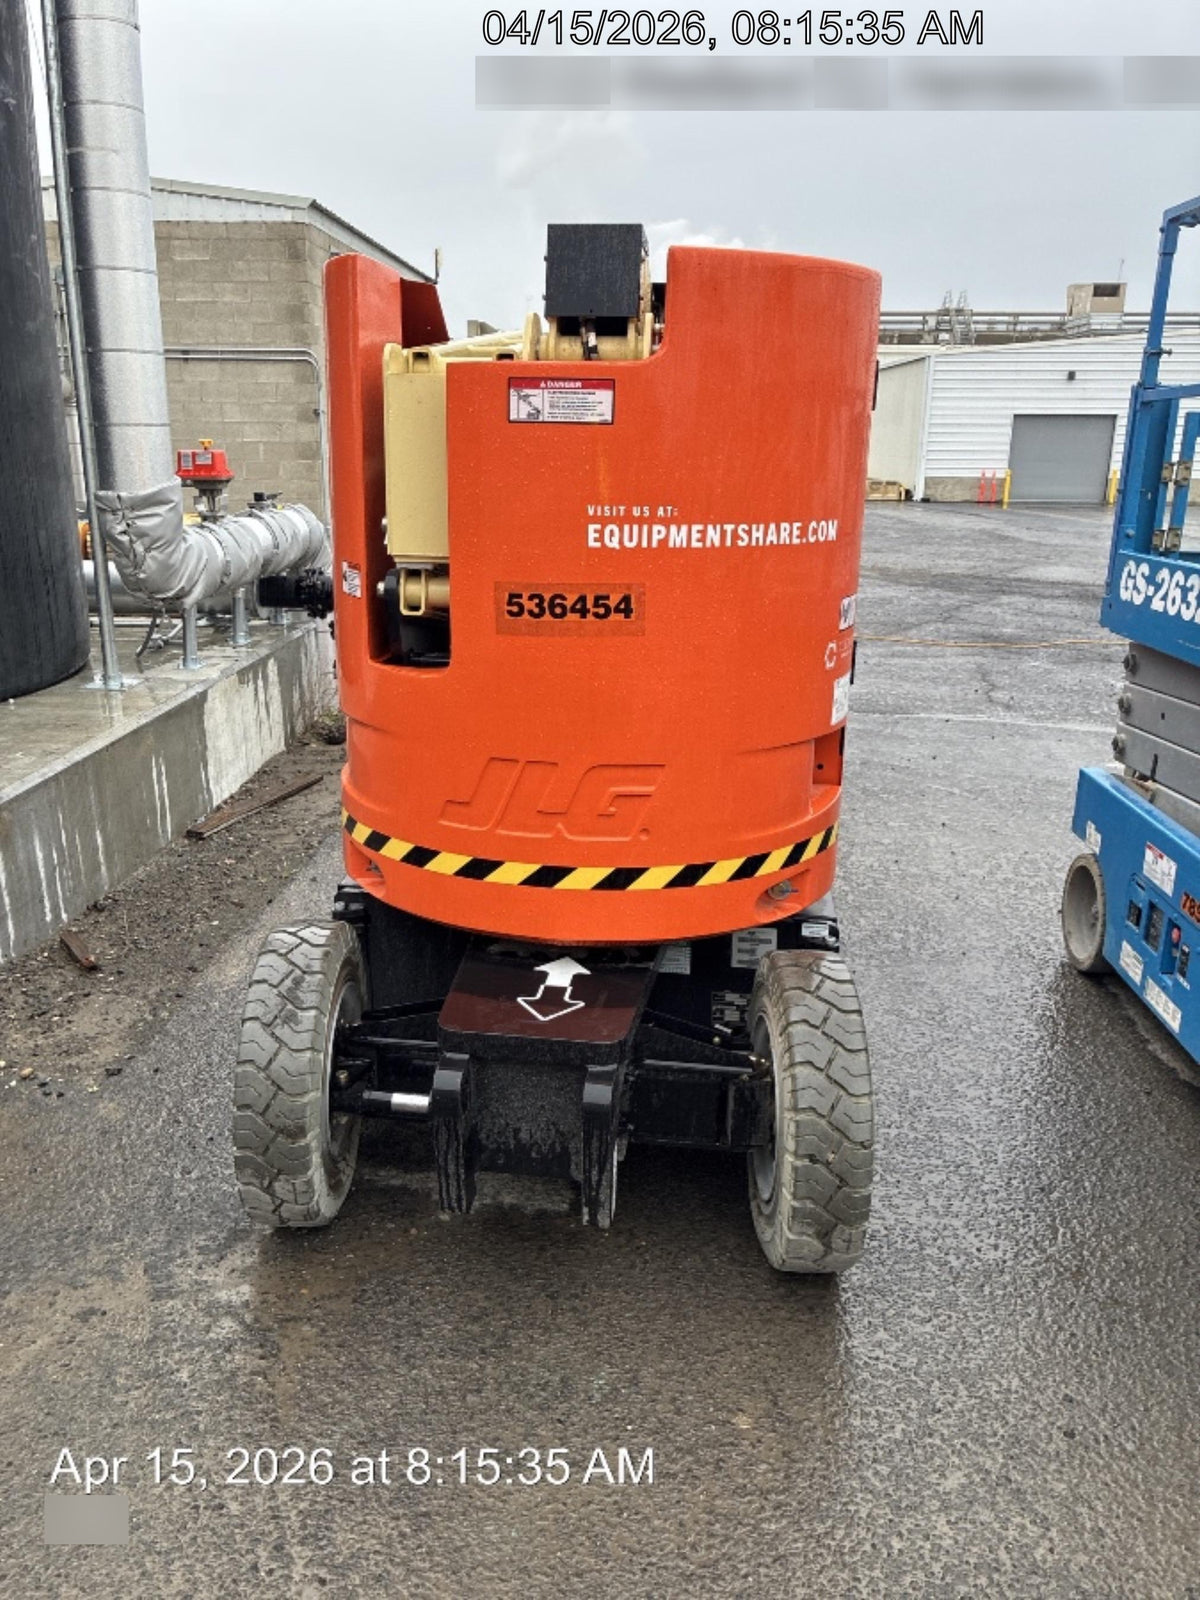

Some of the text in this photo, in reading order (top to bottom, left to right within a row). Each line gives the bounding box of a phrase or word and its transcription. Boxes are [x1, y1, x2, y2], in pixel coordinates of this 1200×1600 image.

[587, 505, 678, 517] VISIT US AT:
[587, 519, 839, 550] EQUIPMENTSHARE.COM
[506, 592, 634, 620] 536454
[1119, 559, 1200, 624] GS-263
[438, 756, 667, 842] JLG
